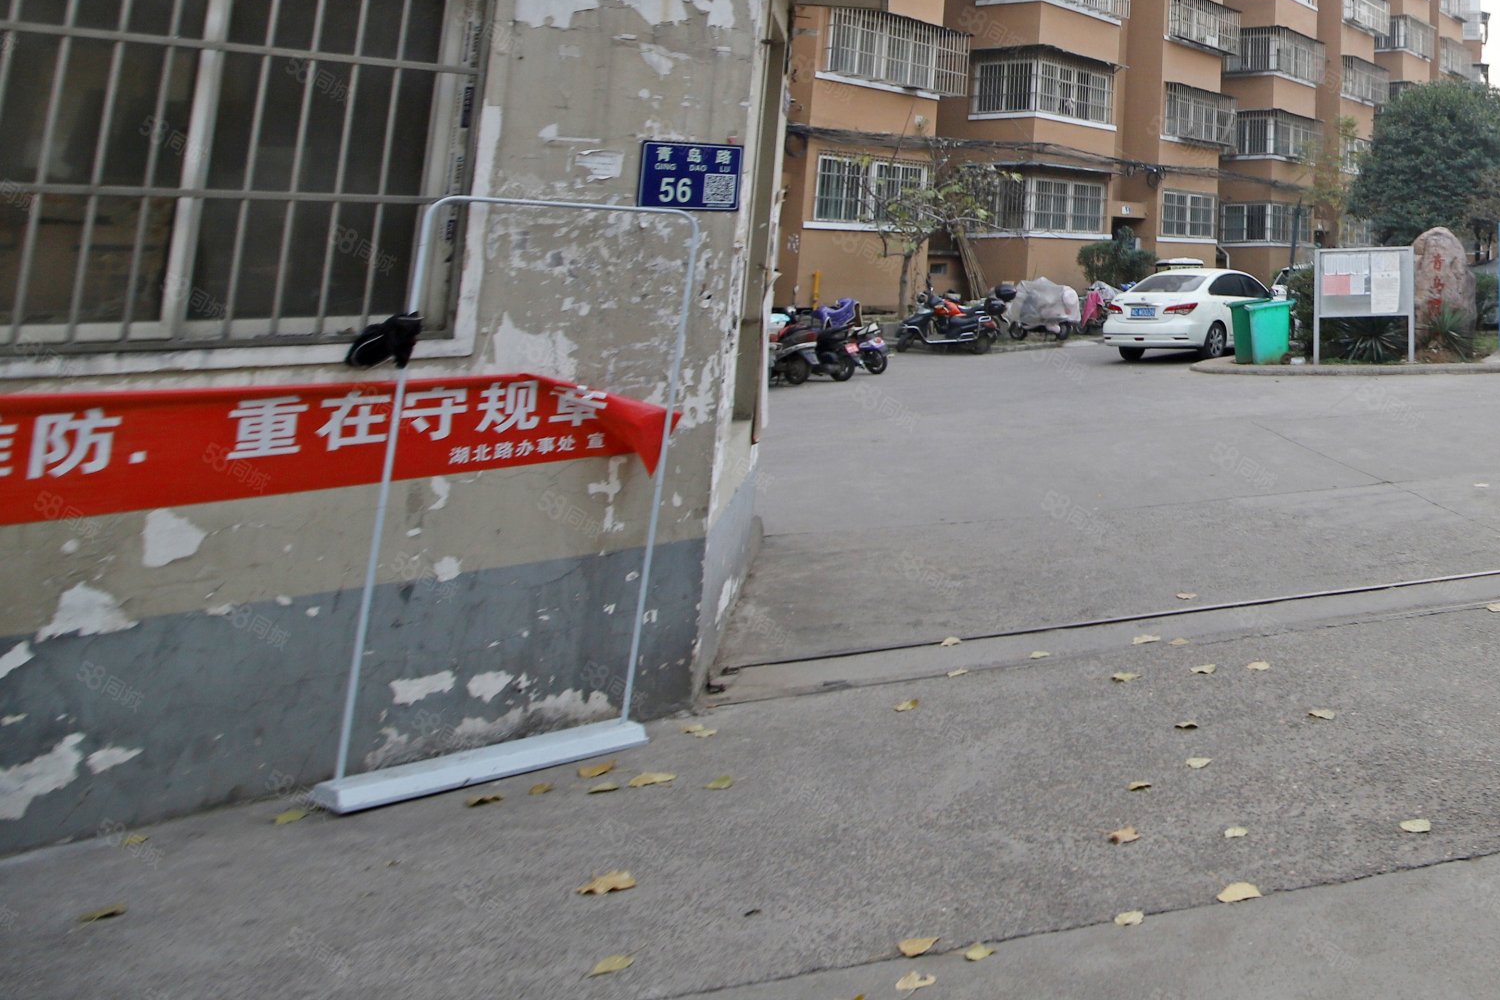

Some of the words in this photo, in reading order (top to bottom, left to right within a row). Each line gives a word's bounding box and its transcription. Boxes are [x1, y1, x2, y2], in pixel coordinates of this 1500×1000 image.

[655, 146, 732, 165] 青岛路
[689, 164, 708, 172] DAO
[658, 177, 692, 203] 56
[448, 435, 576, 465] 湖北路办事处
